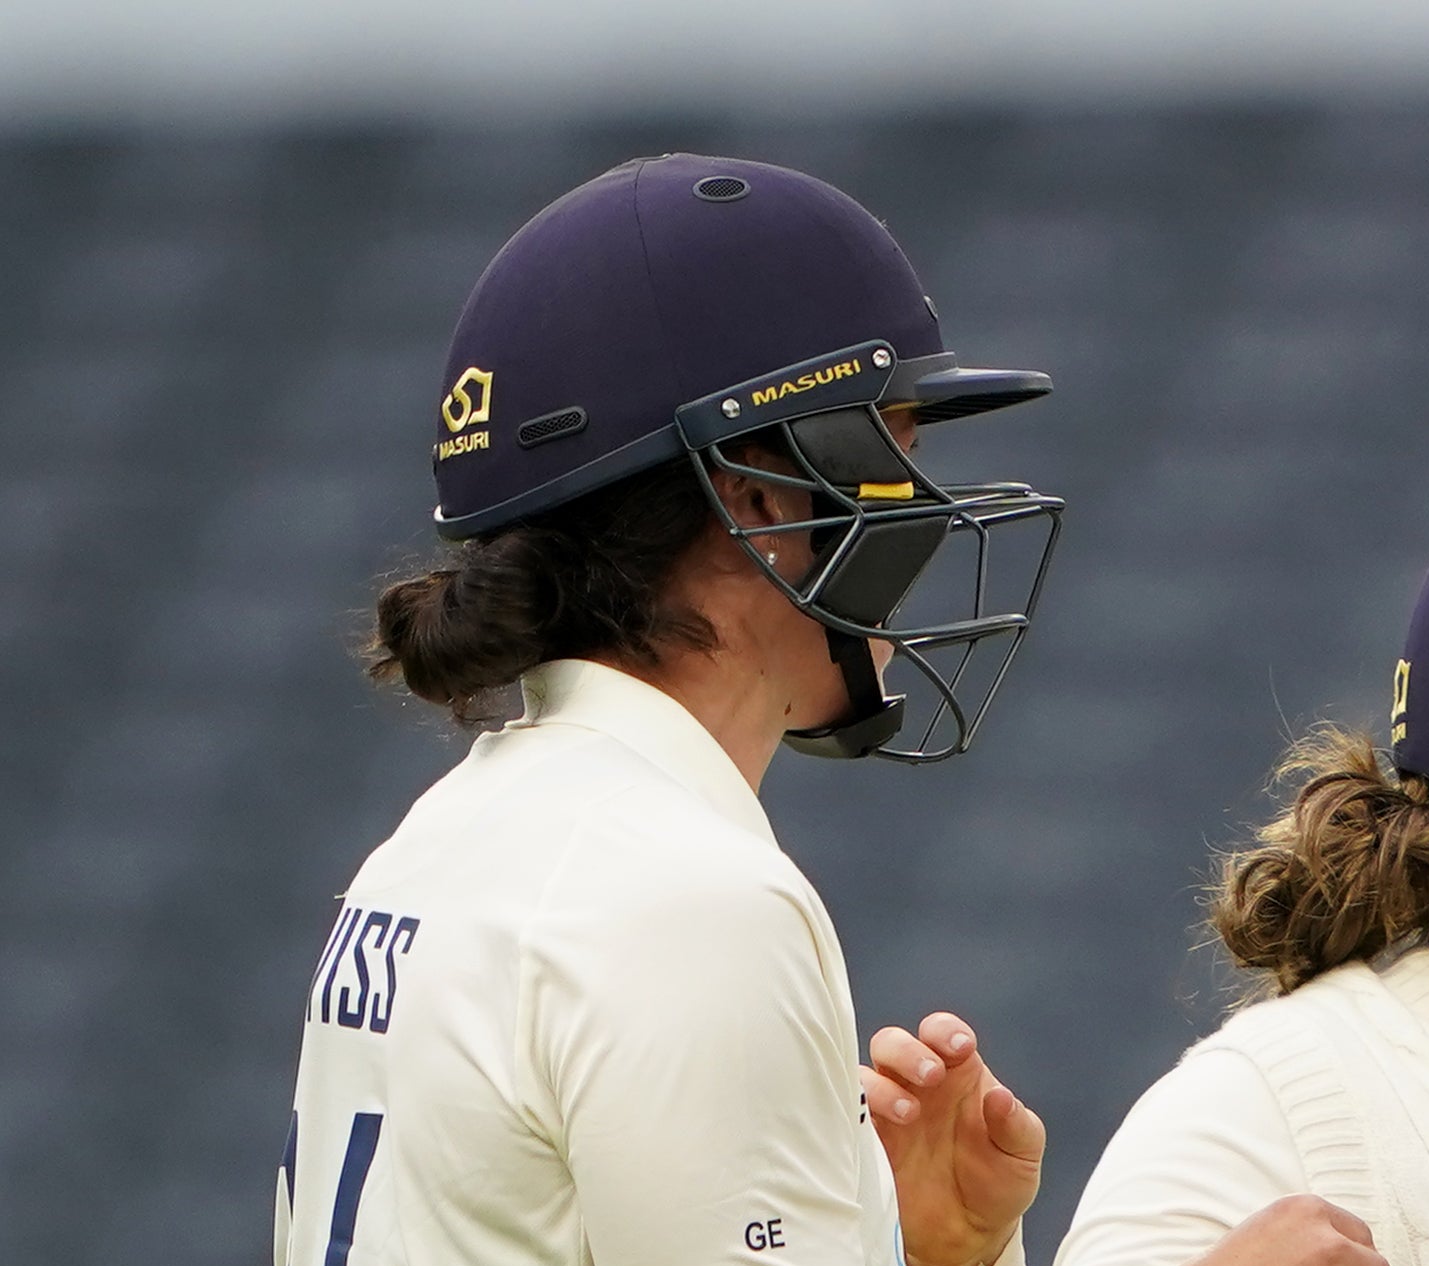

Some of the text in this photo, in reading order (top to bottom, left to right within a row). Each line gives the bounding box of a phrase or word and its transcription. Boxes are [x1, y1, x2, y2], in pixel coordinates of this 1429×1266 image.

[751, 359, 861, 406] MASURI
[439, 431, 490, 461] MASURI
[307, 907, 421, 1035] ISS
[744, 1218, 786, 1251] GE
